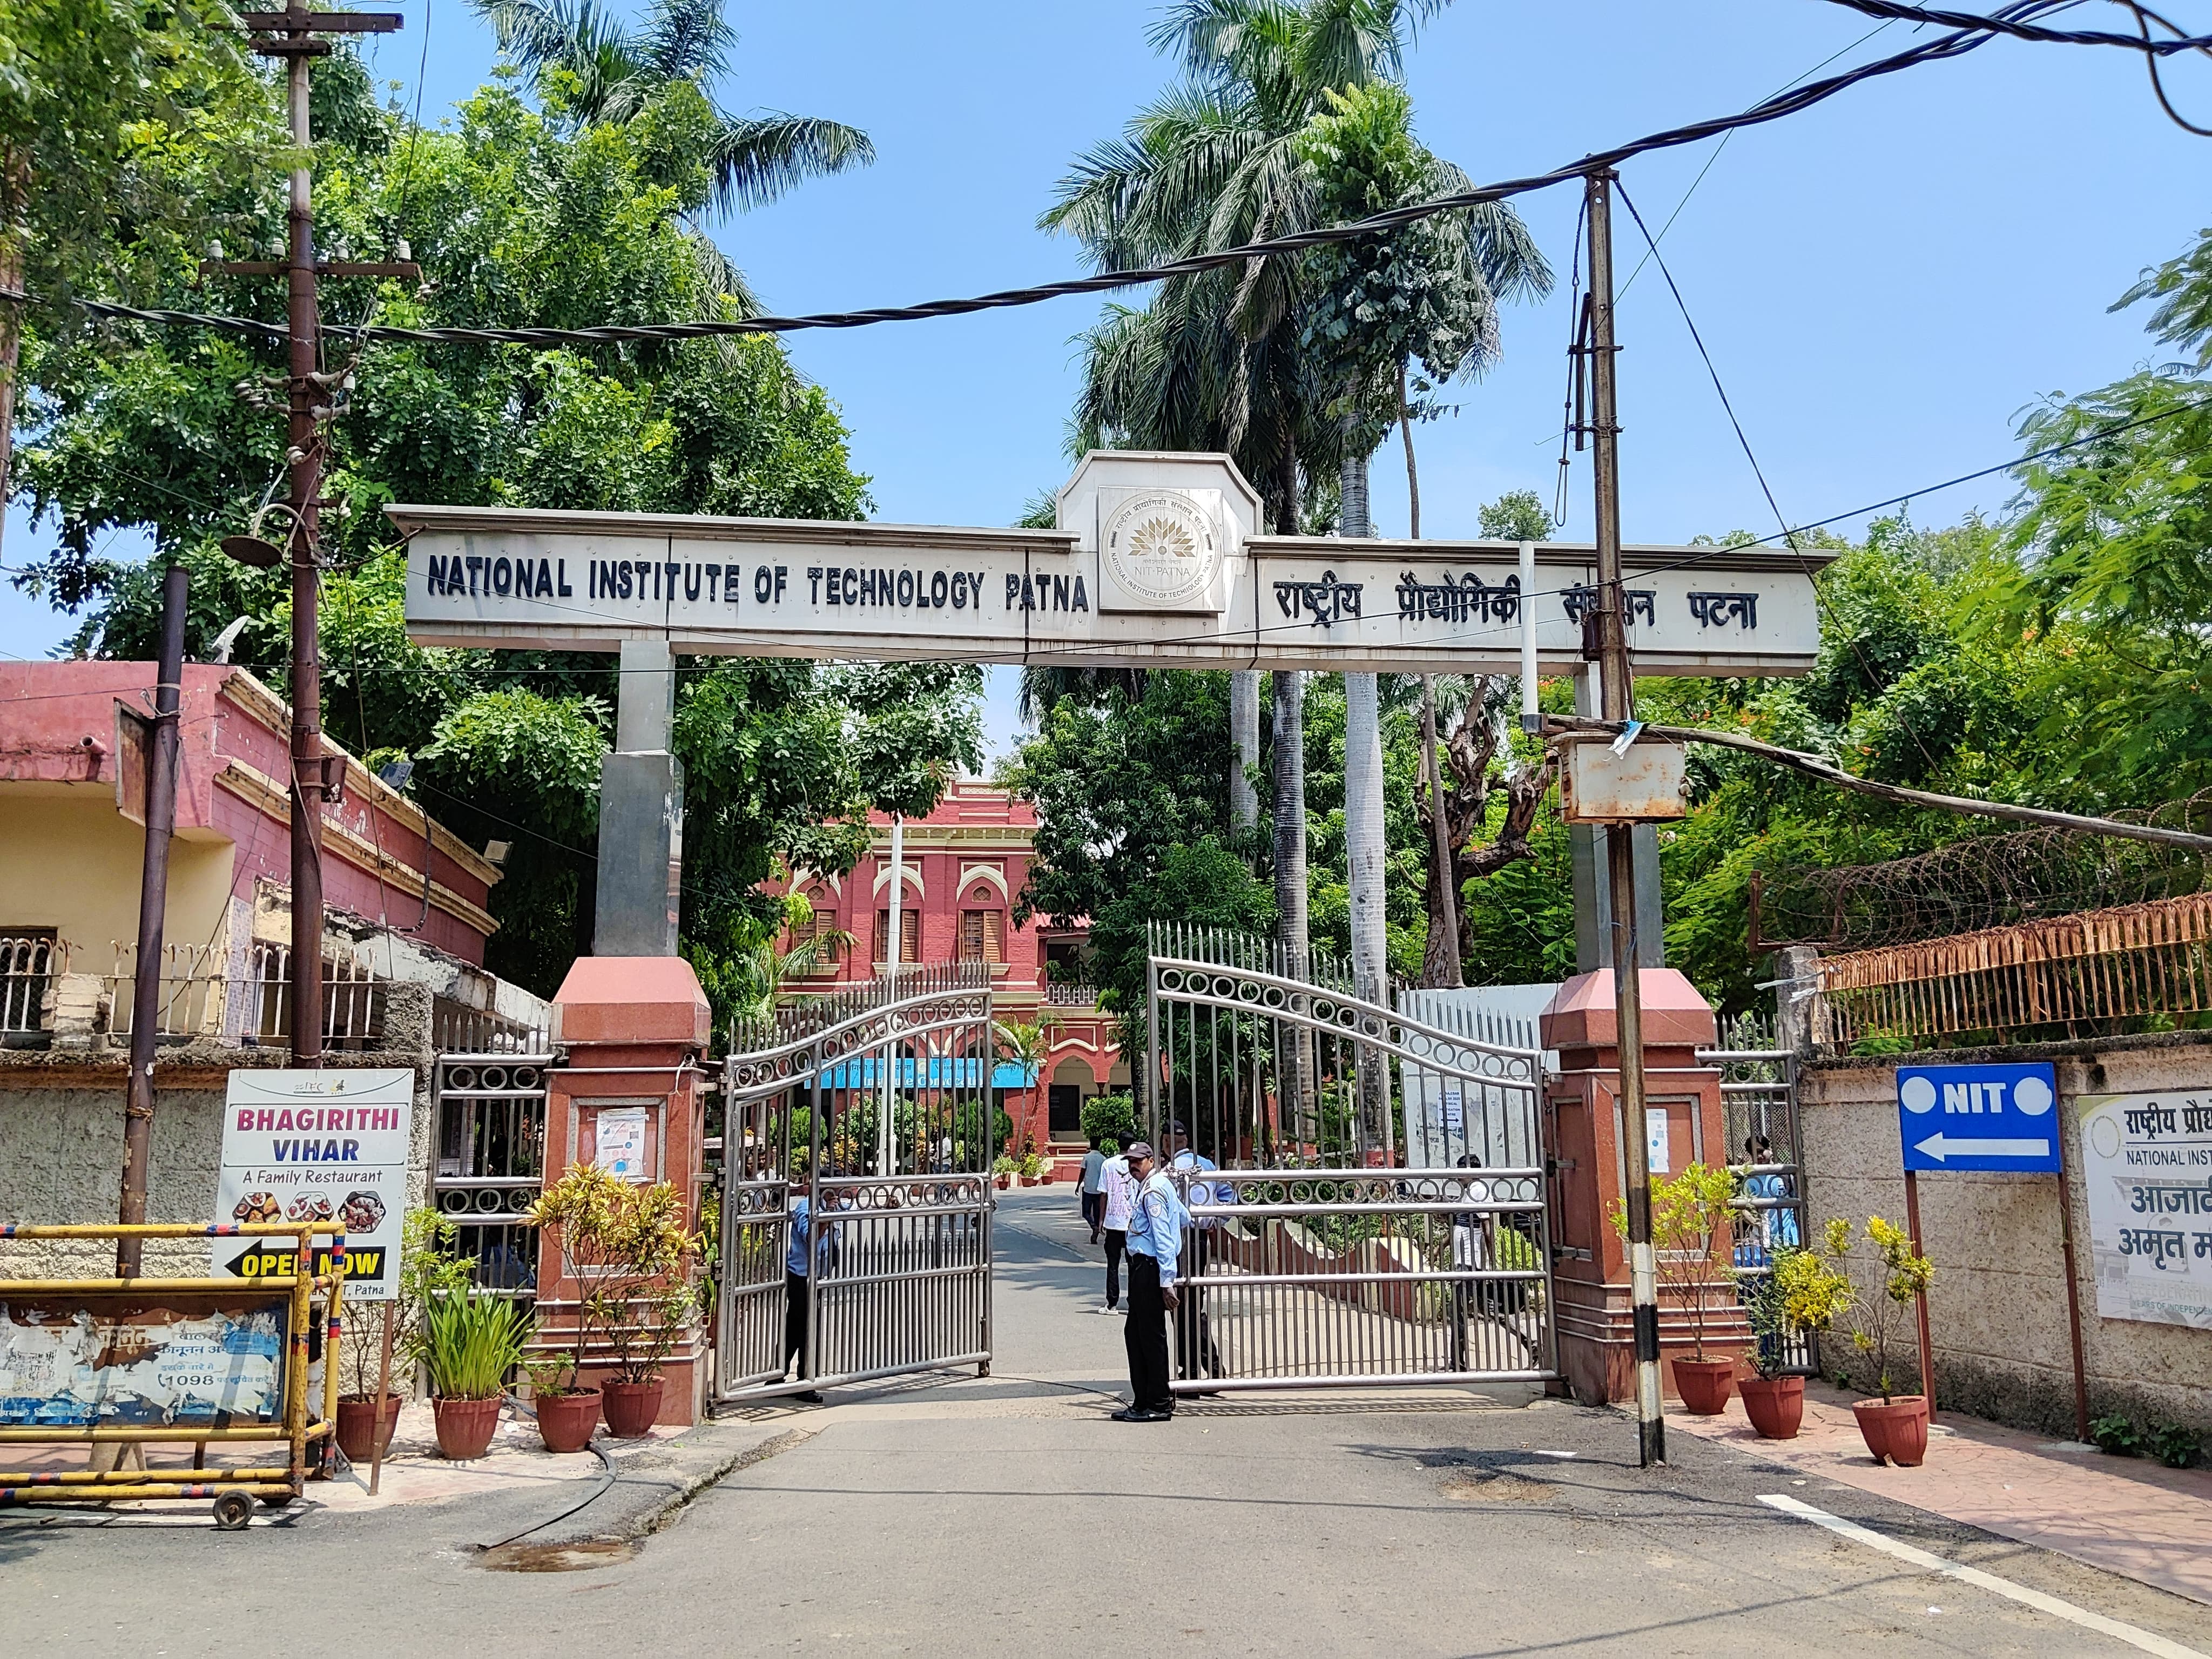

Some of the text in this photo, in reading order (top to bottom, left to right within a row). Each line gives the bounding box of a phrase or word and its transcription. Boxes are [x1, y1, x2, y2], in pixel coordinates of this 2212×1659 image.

[428, 554, 1089, 611] NATIONAL INSTITUTE OF TECHNOLOGY PATNA
[1111, 552, 1128, 582] NATIONAL
[1127, 579, 1157, 598] INSTITUTE
[1169, 574, 1204, 598] TECHNOLOGY
[1273, 570, 1364, 628] राष्ट्रीय
[1395, 569, 1521, 624] प्रौद्योगिकी
[1687, 591, 1759, 629] पटना
[1943, 1082, 2007, 1114] NIT
[237, 1108, 399, 1131] BHAGIRITHI
[2123, 1102, 2176, 1140] राष्ट्रीय
[272, 1138, 360, 1162] VIHAR
[2126, 1150, 2186, 1165] NATIONAL
[242, 1170, 383, 1186] A Family Restaurant
[2118, 1228, 2185, 1270] अमृत
[355, 1284, 385, 1296] Patna
[2133, 1300, 2155, 1309] YEARS
[2156, 1302, 2166, 1310] OF
[165, 1375, 214, 1386] 1098
